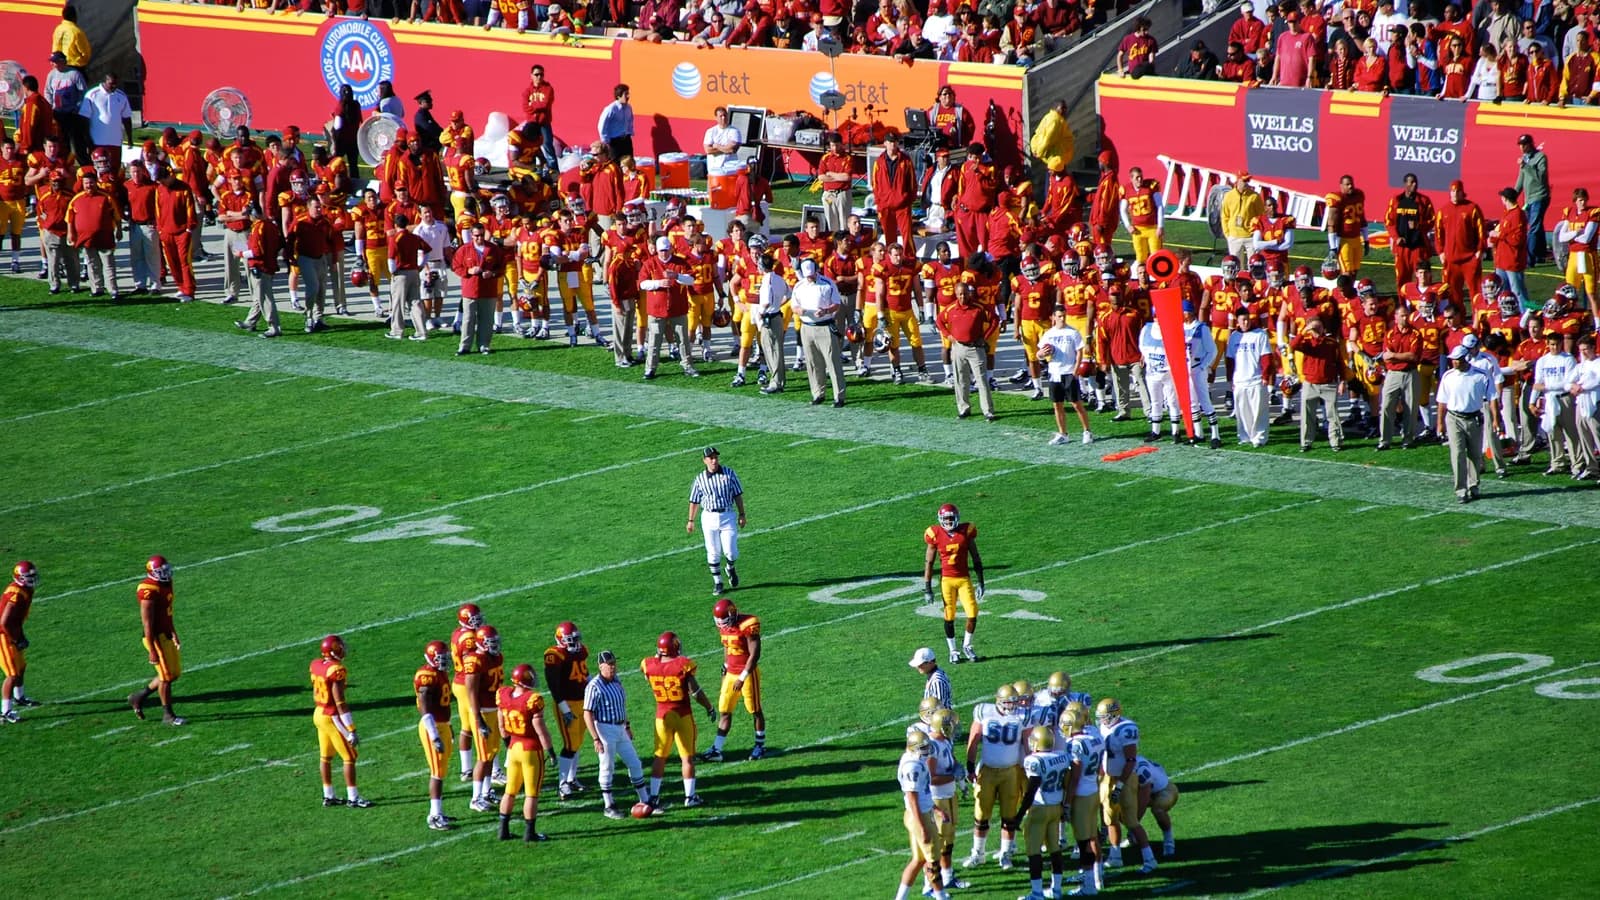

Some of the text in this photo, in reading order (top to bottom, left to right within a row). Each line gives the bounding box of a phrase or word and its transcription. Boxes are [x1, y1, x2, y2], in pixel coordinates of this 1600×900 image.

[324, 21, 388, 57] AUTOMOBILE CLUB
[341, 50, 373, 73] AAA
[707, 72, 750, 95] at&t
[845, 81, 888, 105] at&t
[1248, 113, 1314, 134] WELLS
[1251, 133, 1313, 153] FARGO
[1392, 125, 1458, 145] WELLS
[1394, 144, 1456, 165] FARGO
[888, 275, 912, 296] 57
[945, 543, 960, 565] 7
[1125, 729, 1138, 739] 31
